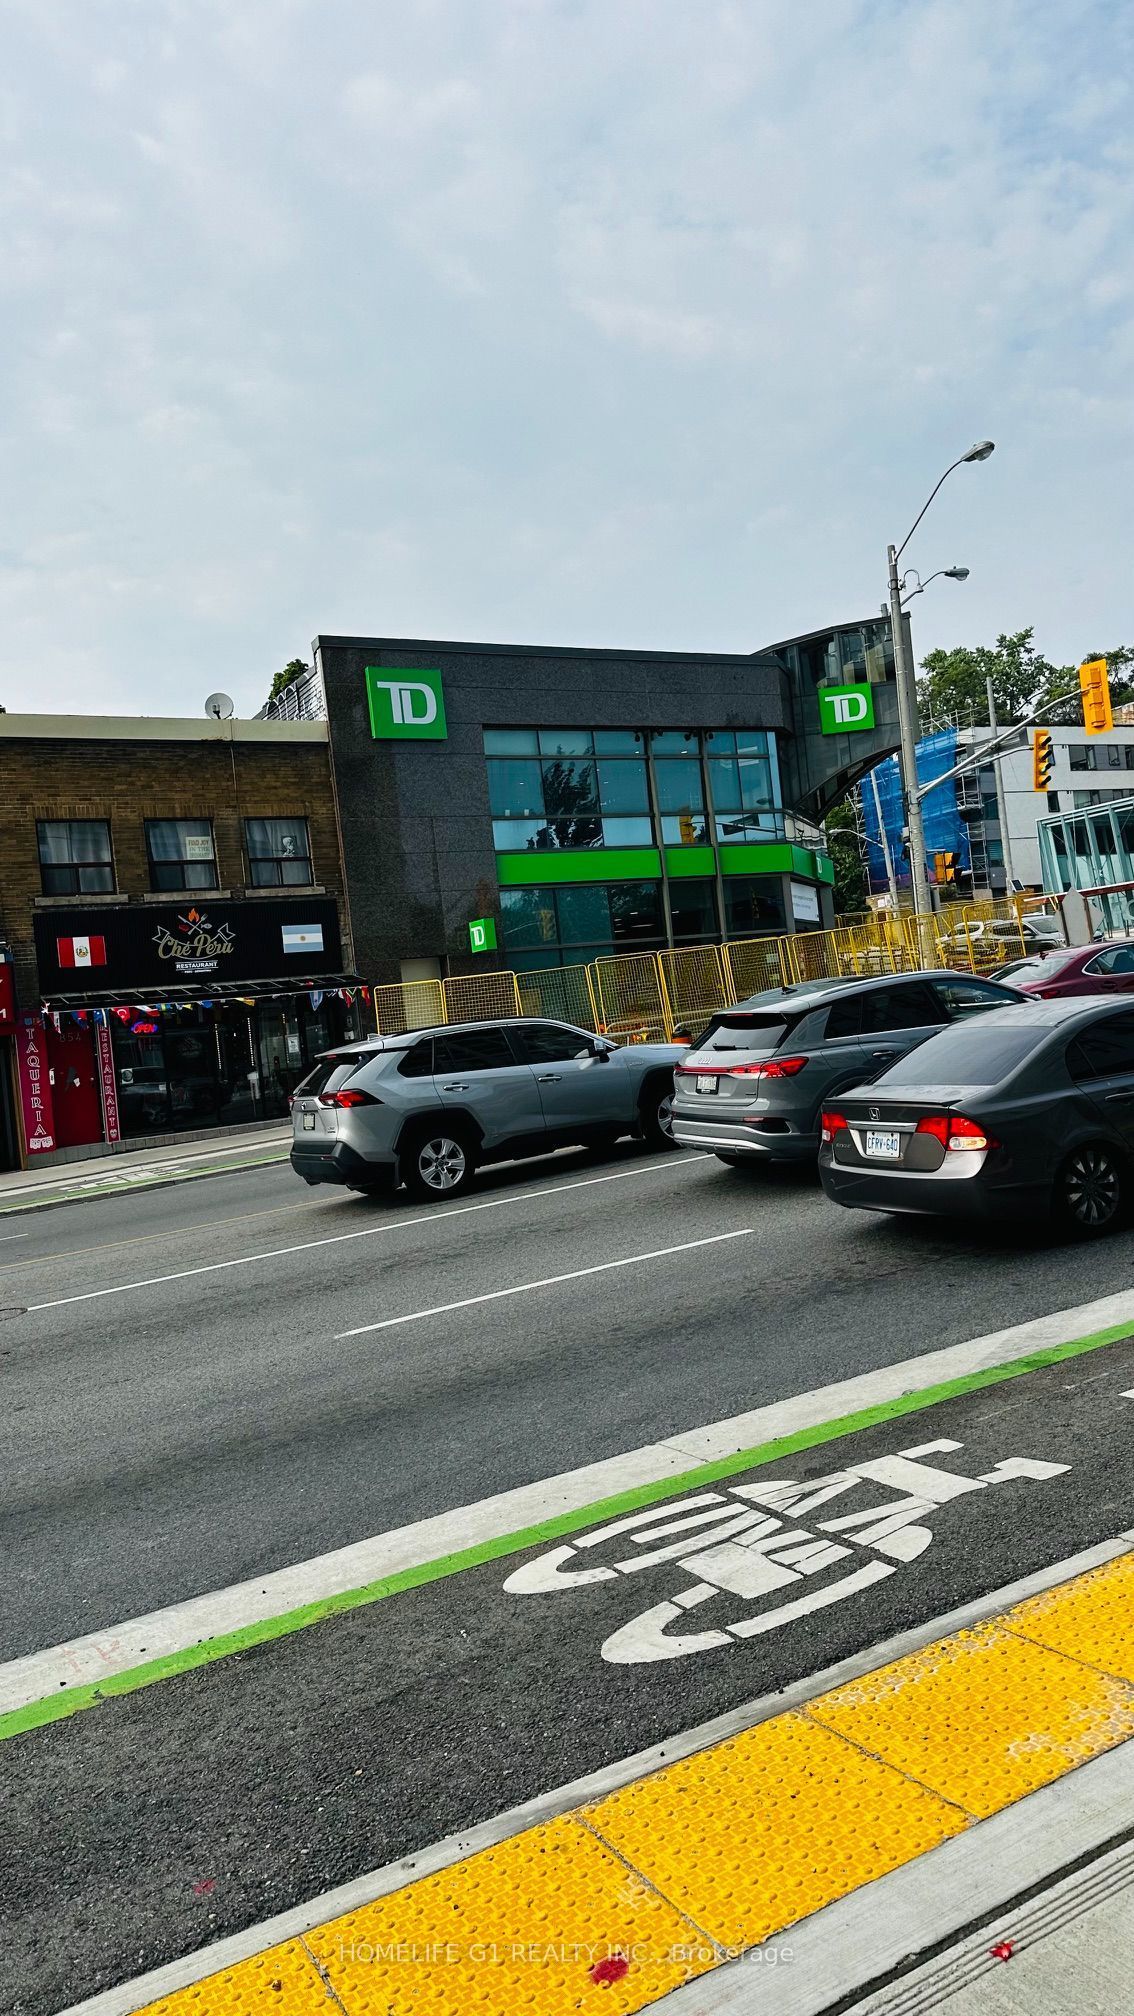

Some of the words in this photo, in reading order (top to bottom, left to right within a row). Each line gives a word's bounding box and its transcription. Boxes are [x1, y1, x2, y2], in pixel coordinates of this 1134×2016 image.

[377, 681, 437, 725] TD
[824, 692, 868, 724] TD
[194, 933, 234, 957] Peru
[470, 925, 485, 947] TD
[176, 961, 218, 969] RESTAURANT
[26, 1028, 46, 1136] TAQUERIA
